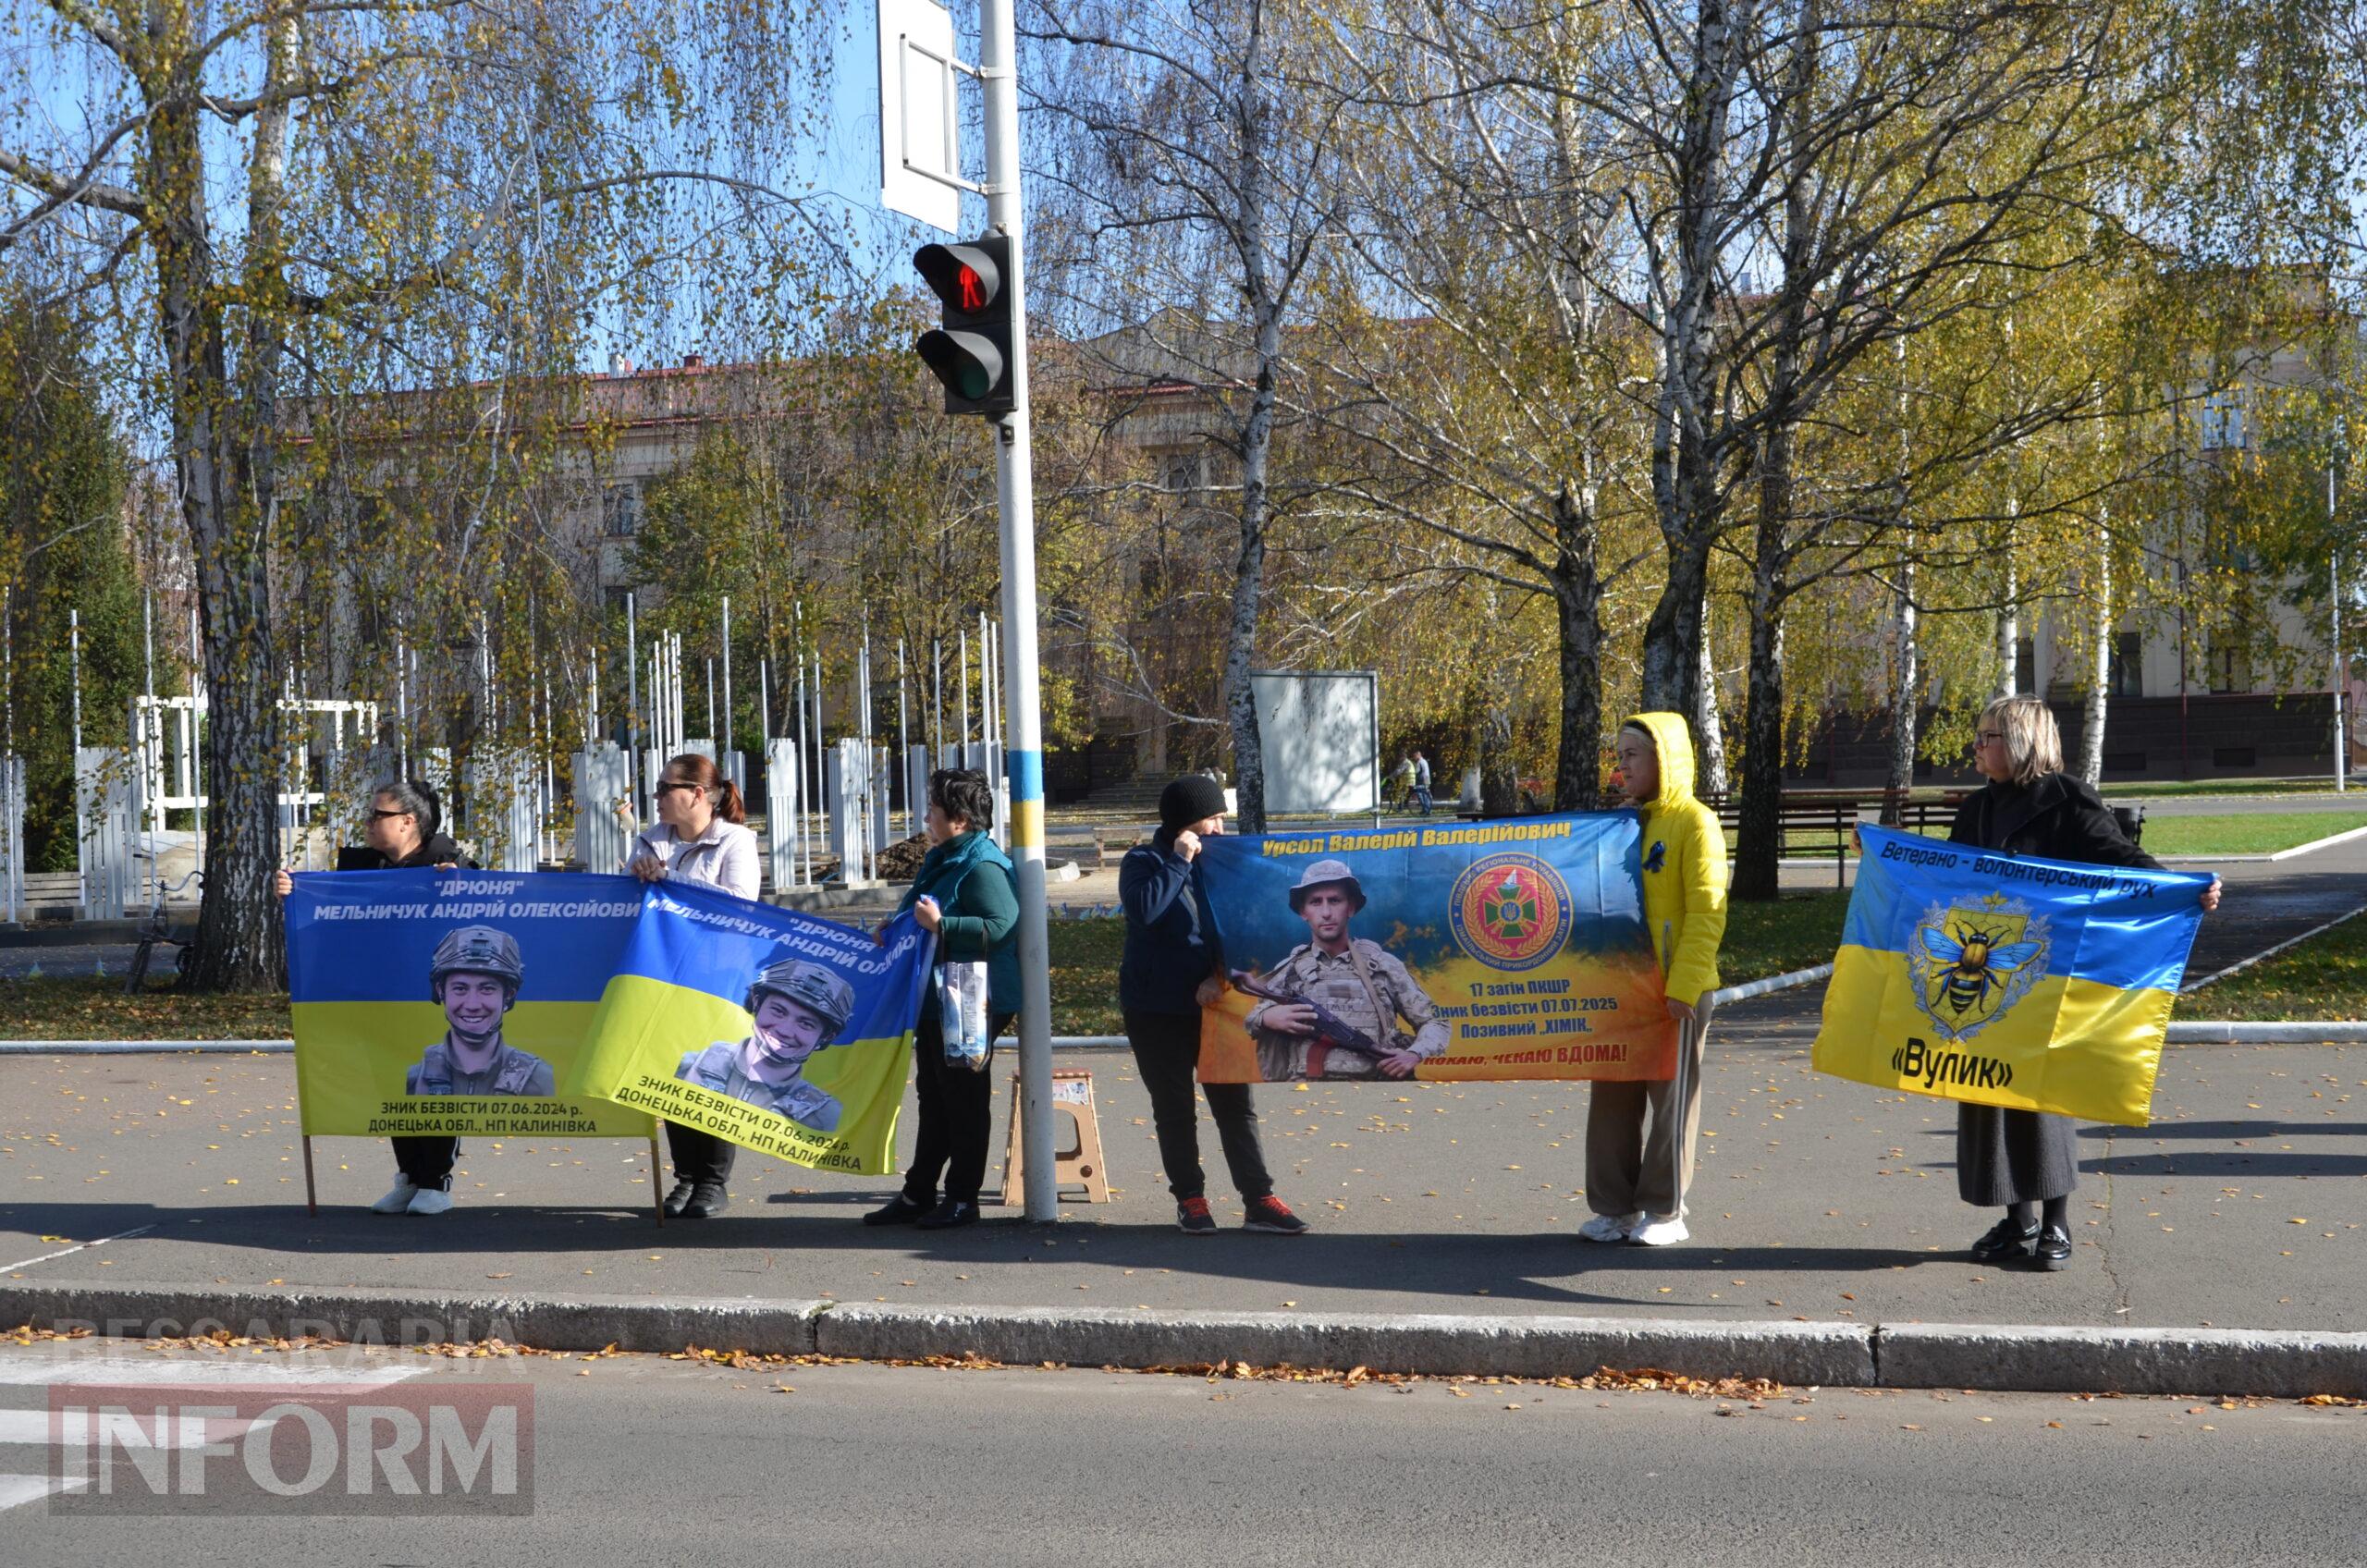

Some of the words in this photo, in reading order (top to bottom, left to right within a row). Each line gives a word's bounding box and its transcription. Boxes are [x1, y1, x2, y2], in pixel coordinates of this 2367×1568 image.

[1262, 836, 1324, 856] Урсол
[1328, 828, 1417, 852] Валерій
[1421, 822, 1572, 846] Валерійович
[1880, 840, 1957, 868] Ветерано
[1973, 857, 2116, 890] волонтерський
[2118, 878, 2157, 899] рух
[435, 880, 524, 897] "ДРЮНЯ"
[314, 903, 427, 920] МЕЛЬНИЧУК
[431, 900, 504, 919] АНДРІЙ
[647, 898, 777, 940] МЕЛЬНИЧУК
[774, 933, 859, 969] АНДРІЙ
[790, 917, 881, 953] "ДРЮНЯ
[1469, 983, 1483, 997] 17
[1487, 982, 1525, 997] загін
[1527, 979, 1571, 994] ПКШР
[1431, 1004, 1468, 1019] Зник
[1471, 1001, 1538, 1017] безвісти
[1540, 998, 1618, 1014] 07.07.2025
[1461, 1021, 1536, 1039] Позивний
[1492, 1049, 1552, 1064] ЧЕКАЮ
[1557, 1045, 1627, 1065] ВДОМА!
[1892, 1036, 2013, 1089] «Вулик»
[381, 1102, 417, 1114] ЗНИК
[421, 1102, 487, 1114] БЕЗВІСТИ
[491, 1102, 567, 1115] 07.06.2024
[570, 1106, 583, 1118] р.
[638, 1075, 685, 1098] ЗНИК
[684, 1087, 760, 1125] БЕЗВІСТИ
[761, 1118, 839, 1151] 07.06.2024
[368, 1119, 442, 1133] ДОНЕЦЬКА
[446, 1120, 482, 1133] ОБЛ.,
[485, 1120, 506, 1131] НП
[510, 1120, 596, 1133] КАЛИНІВКА
[616, 1086, 703, 1125] ДОНЕЦЬКА
[707, 1116, 745, 1141] ОБЛ.,
[750, 1131, 774, 1150] НП
[776, 1143, 862, 1170] КАЛИНІВКА
